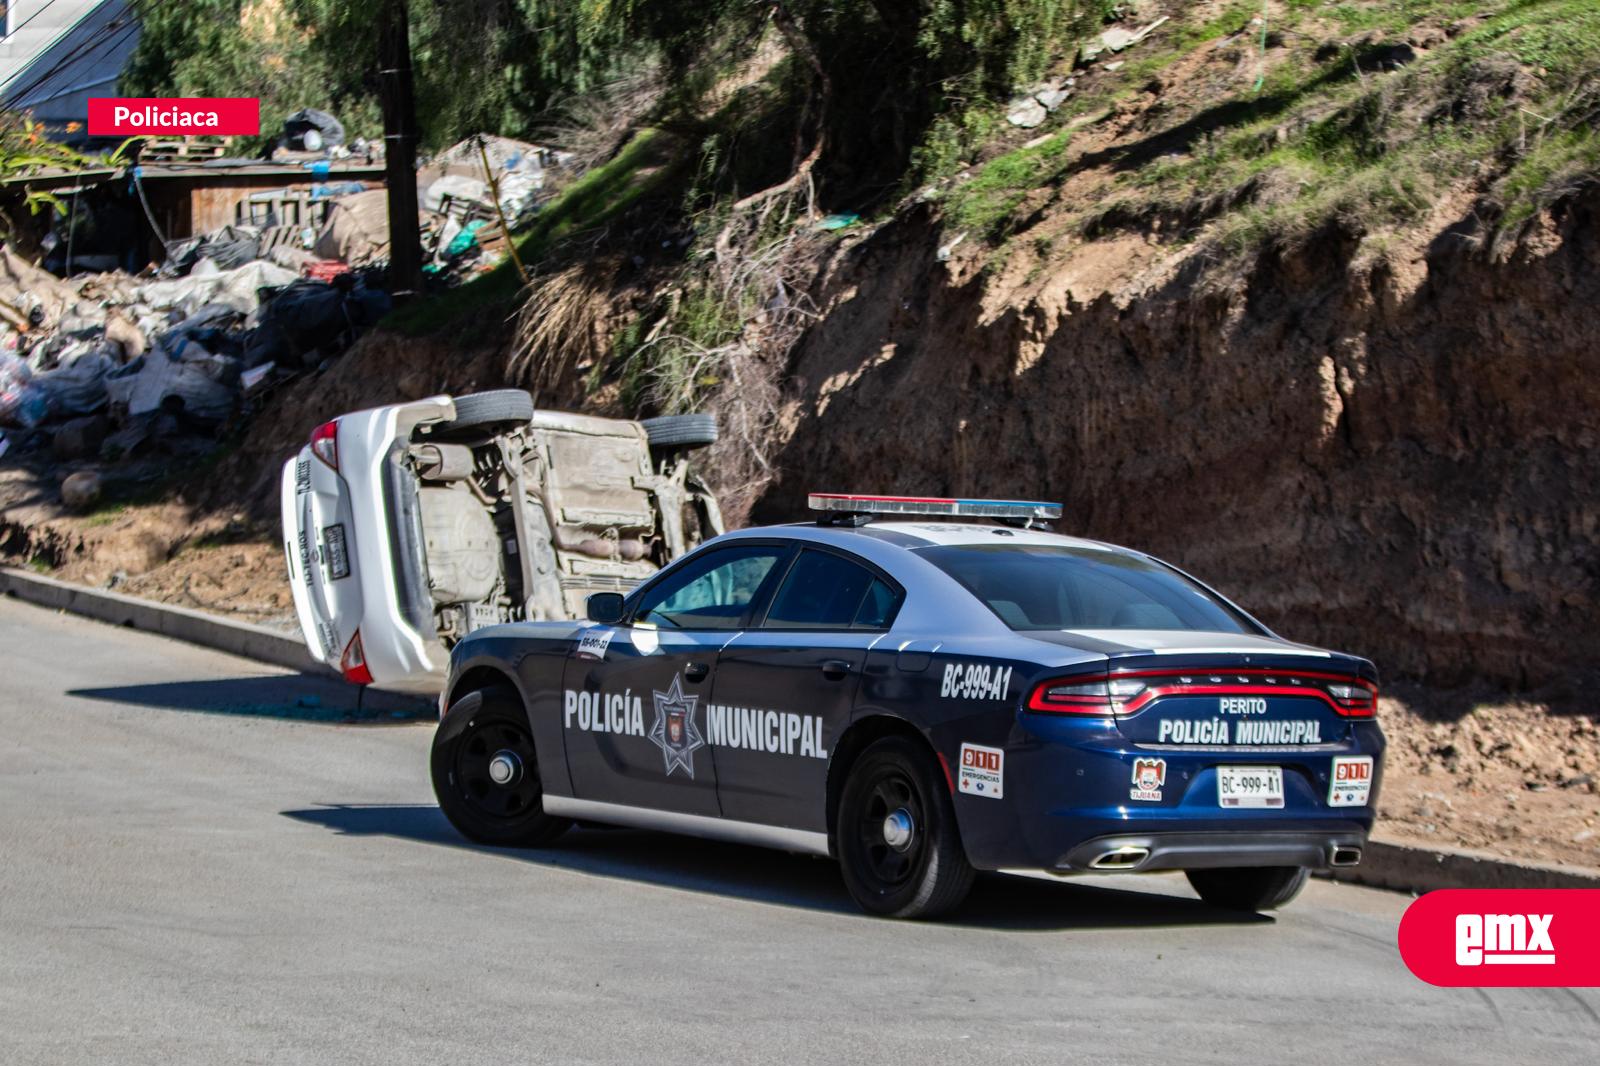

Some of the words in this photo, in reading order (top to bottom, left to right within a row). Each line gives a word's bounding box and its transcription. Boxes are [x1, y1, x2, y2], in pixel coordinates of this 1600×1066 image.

[940, 663, 1013, 701] BC-999-A1
[1219, 697, 1267, 714] PERITO
[565, 688, 645, 737] POLICÍA
[706, 704, 828, 760] MUNICIPAL
[1158, 716, 1229, 744] POLICÍA
[1235, 720, 1322, 744] MUNICIPAL
[964, 750, 999, 771] 911
[961, 770, 1000, 783] EMERGENCIAS
[1337, 763, 1369, 780] 911
[1222, 776, 1280, 793] BC-999-A1
[1132, 791, 1161, 799] TIJUANA
